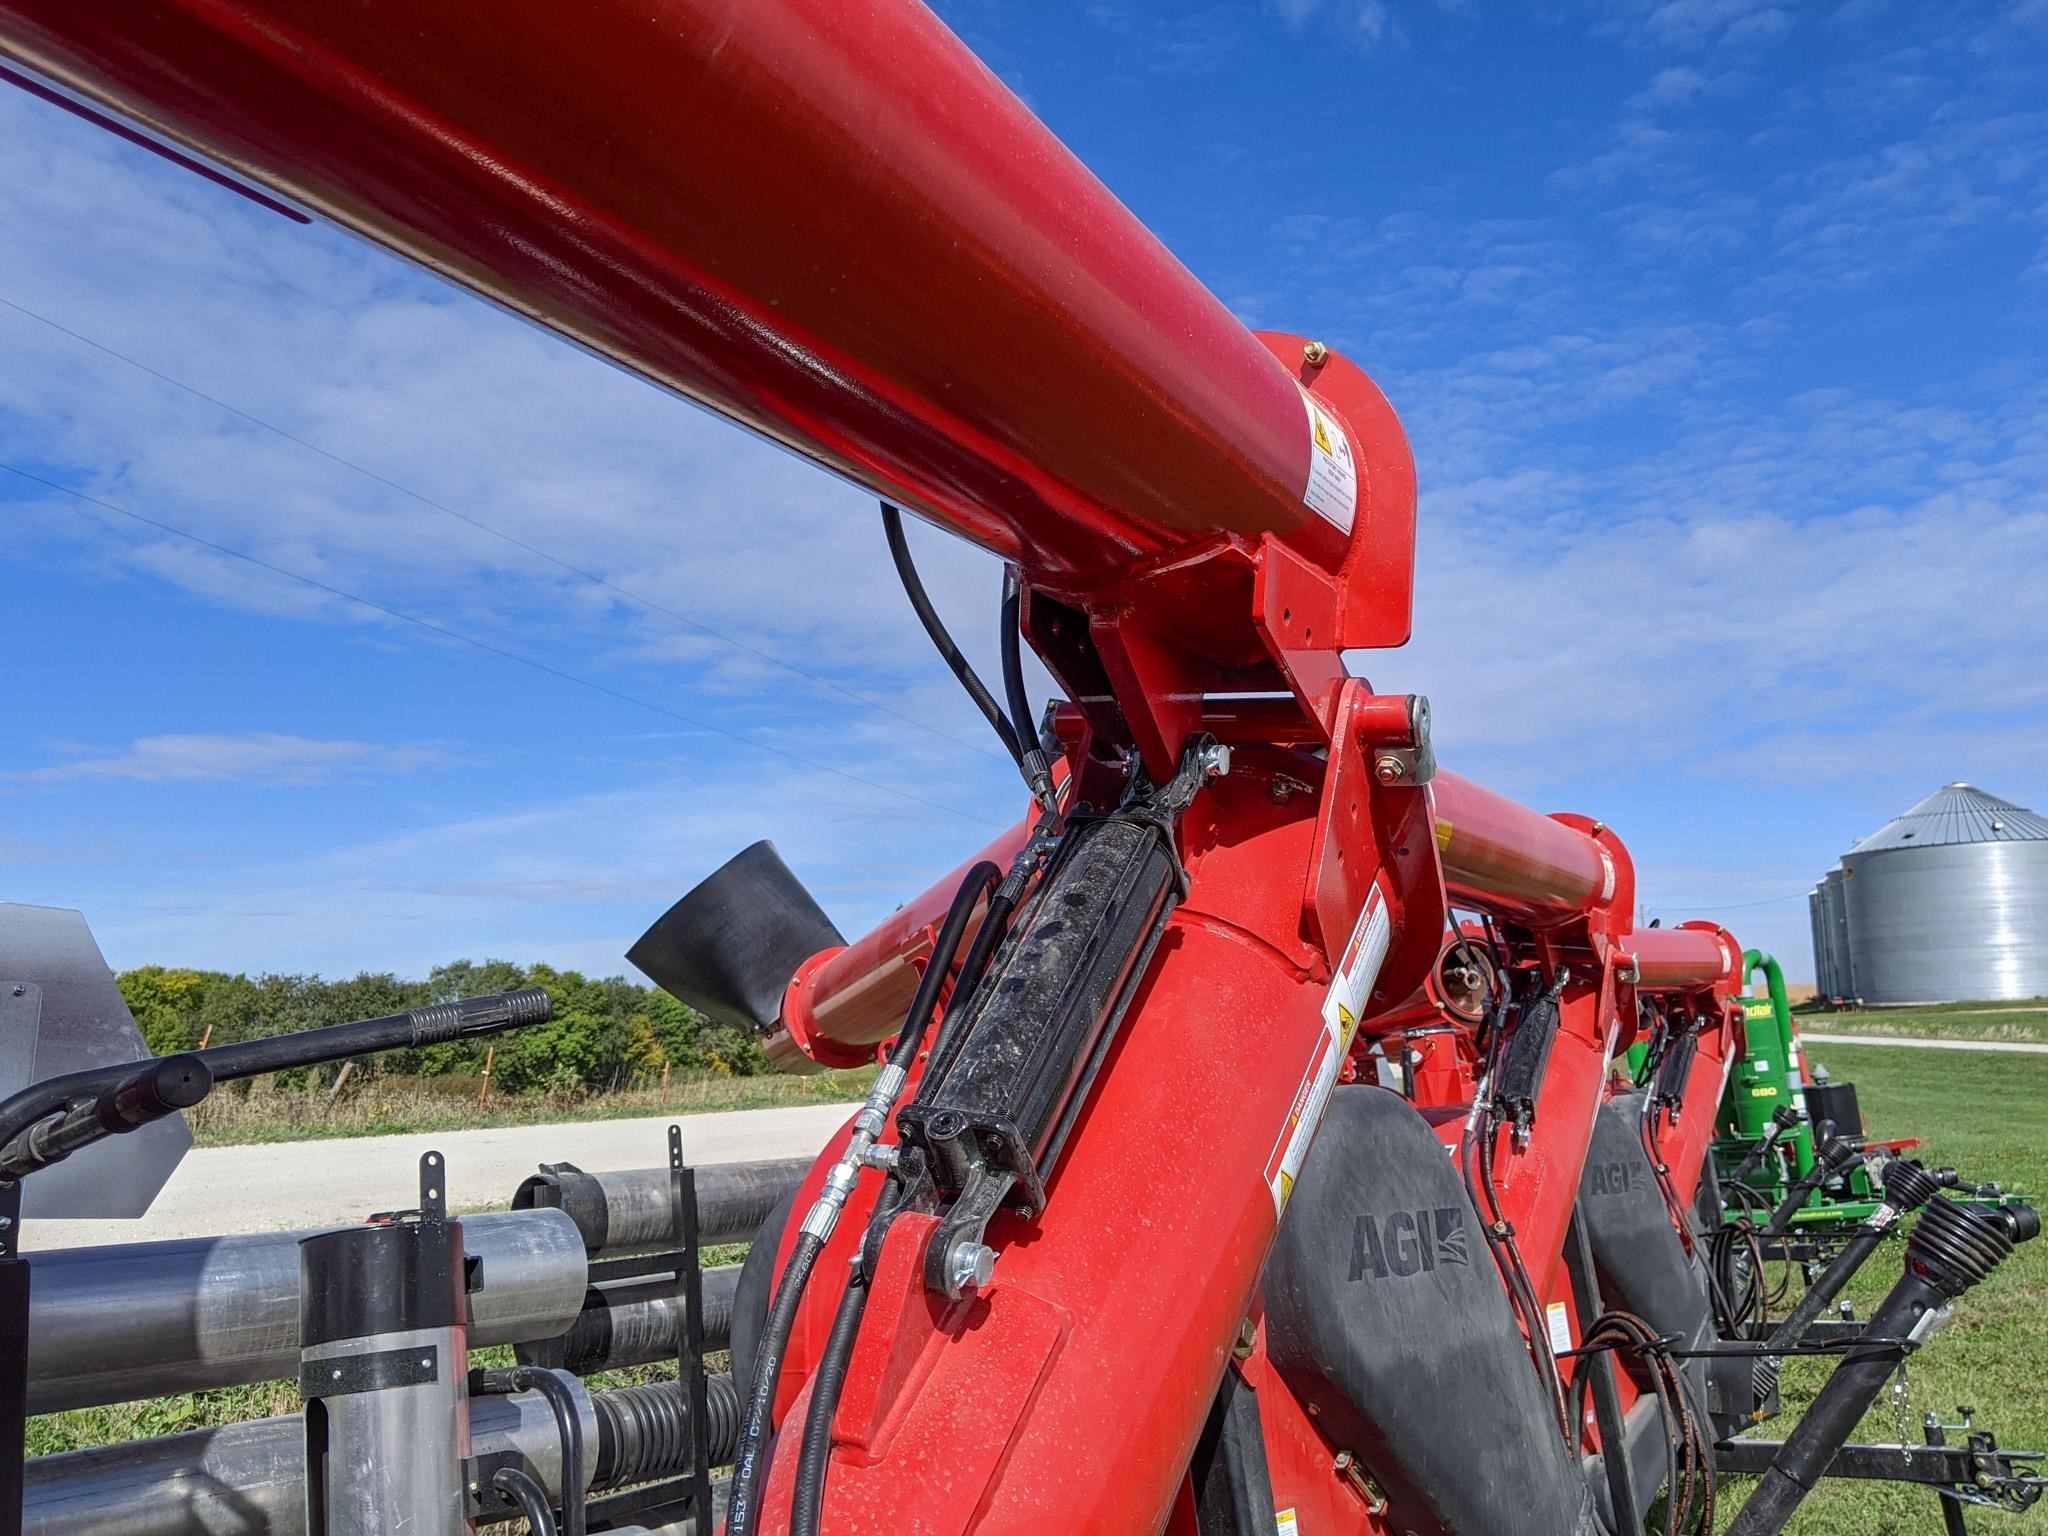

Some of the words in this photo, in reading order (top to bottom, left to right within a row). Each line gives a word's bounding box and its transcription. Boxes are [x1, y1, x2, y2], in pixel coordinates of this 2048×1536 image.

[1356, 911, 1371, 942] DANGER
[1295, 1079, 1311, 1117] DANGER
[1590, 1162, 1630, 1195] AGI
[1348, 1210, 1435, 1281] AGI
